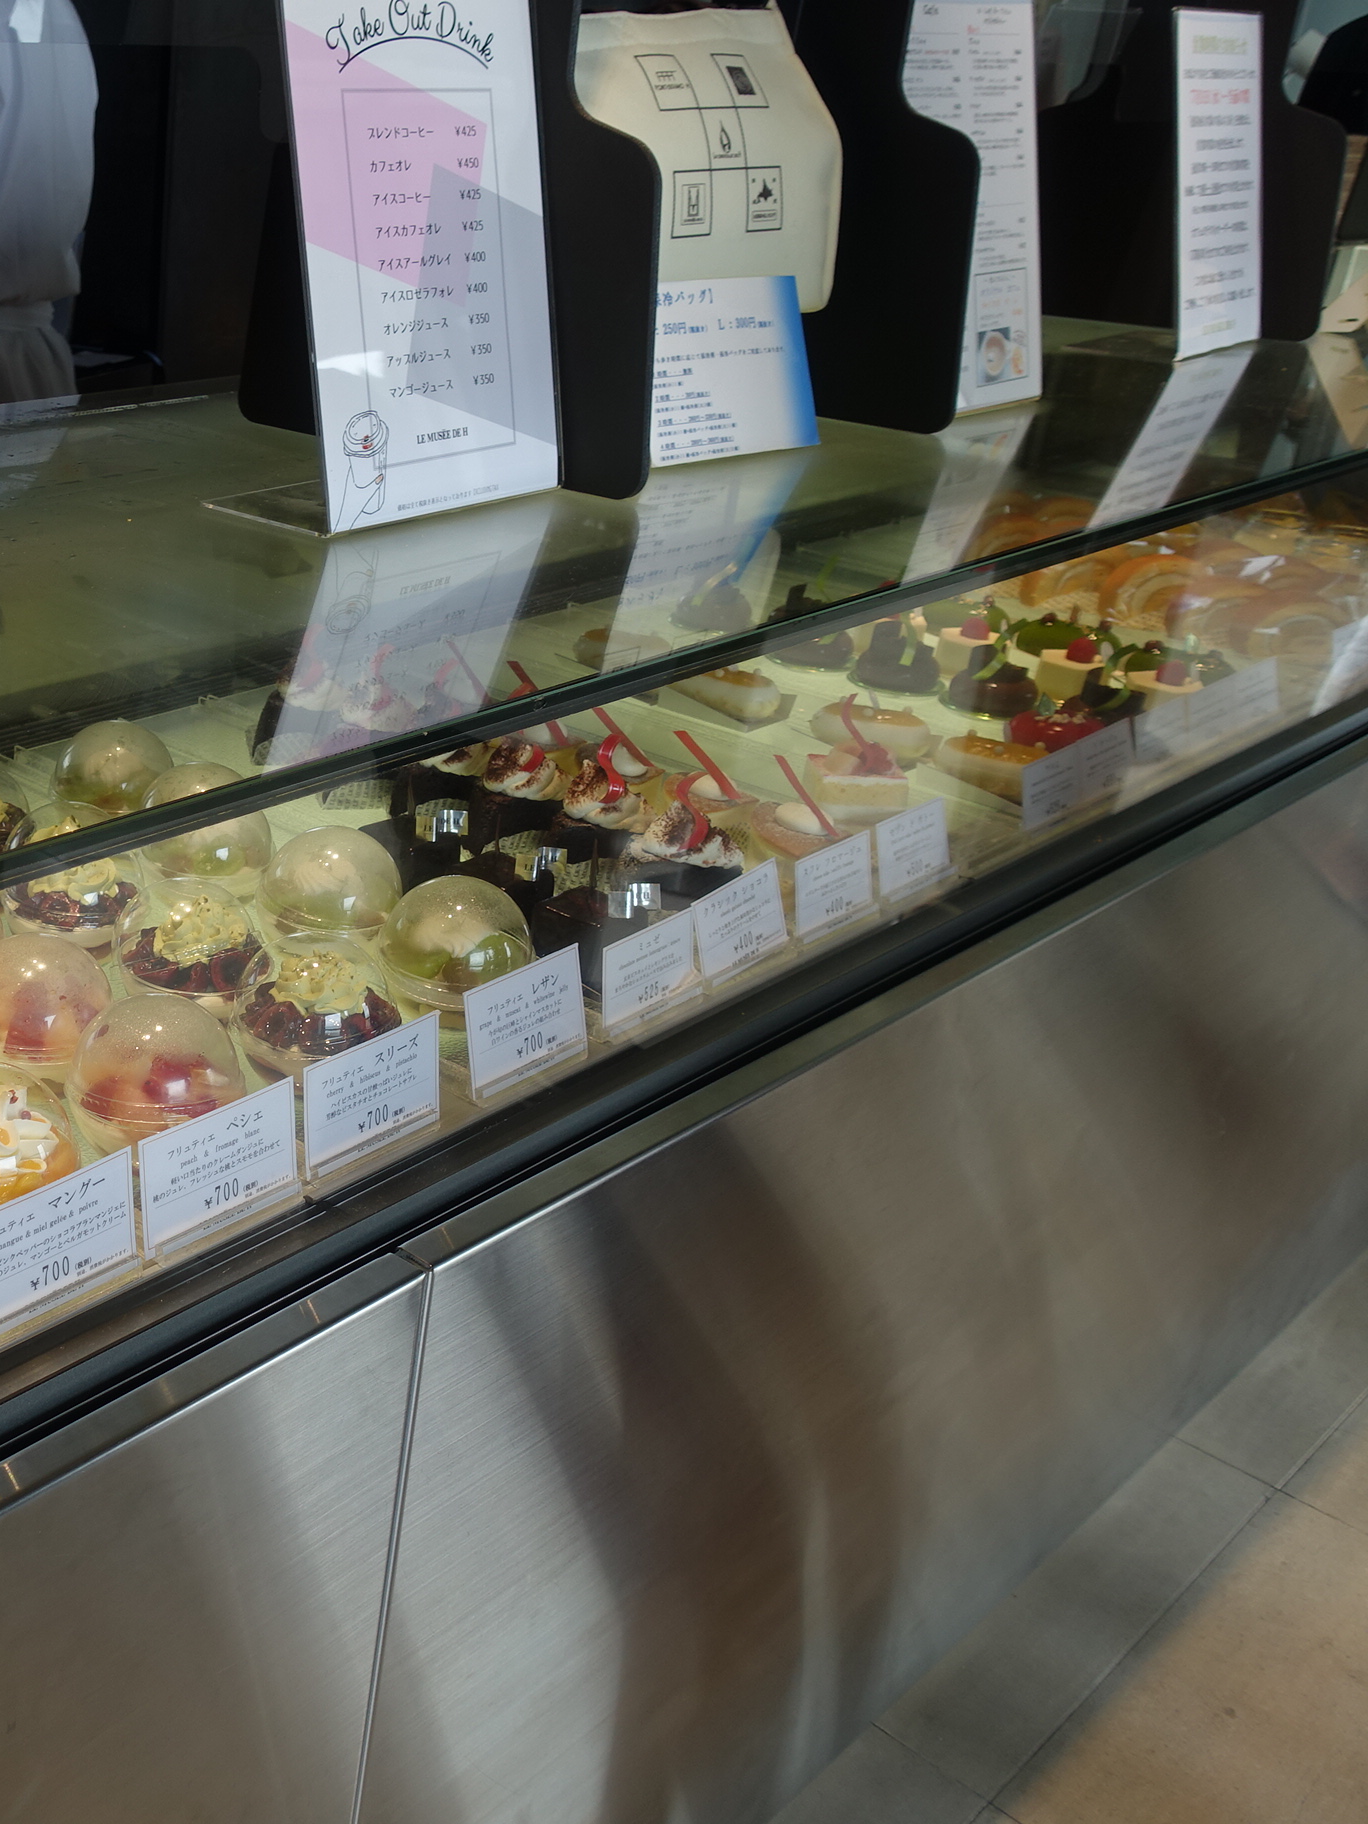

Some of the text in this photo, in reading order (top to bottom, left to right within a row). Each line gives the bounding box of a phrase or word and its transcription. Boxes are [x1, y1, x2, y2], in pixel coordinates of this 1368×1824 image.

[325, 0, 494, 66] Take Out Drink
[454, 125, 477, 137] ¥425
[370, 157, 480, 173] カフェオレ ¥450
[372, 188, 482, 207] アイスコーヒー ¥425
[375, 220, 484, 239] アイスカフェオレ ¥425
[378, 250, 487, 272] アイスアールグレイ ¥400
[466, 281, 488, 294] ¥400
[383, 312, 490, 335] オレンジジュース ¥350
[470, 343, 492, 355] ¥350
[389, 373, 495, 398] マンゴージュース ¥350
[416, 426, 469, 445] LE DE H
[531, 973, 560, 995] レザン
[516, 1031, 543, 1059] ¥700
[321, 1033, 420, 1090] フリュティエ スリーズ
[326, 1086, 344, 1100] cherry
[349, 1081, 355, 1089] &
[357, 1103, 389, 1133] ¥700
[167, 1110, 264, 1160] フリュティエ ペシェ
[180, 1127, 261, 1170] peach & fromage blanc
[48, 1177, 106, 1209] マングー
[204, 1177, 240, 1210] ¥700
[25, 1230, 32, 1239] &
[33, 1223, 48, 1236] miel
[49, 1214, 68, 1231] gelée
[68, 1210, 75, 1219] &
[78, 1199, 99, 1216] poivre
[30, 1255, 71, 1292] ¥700
